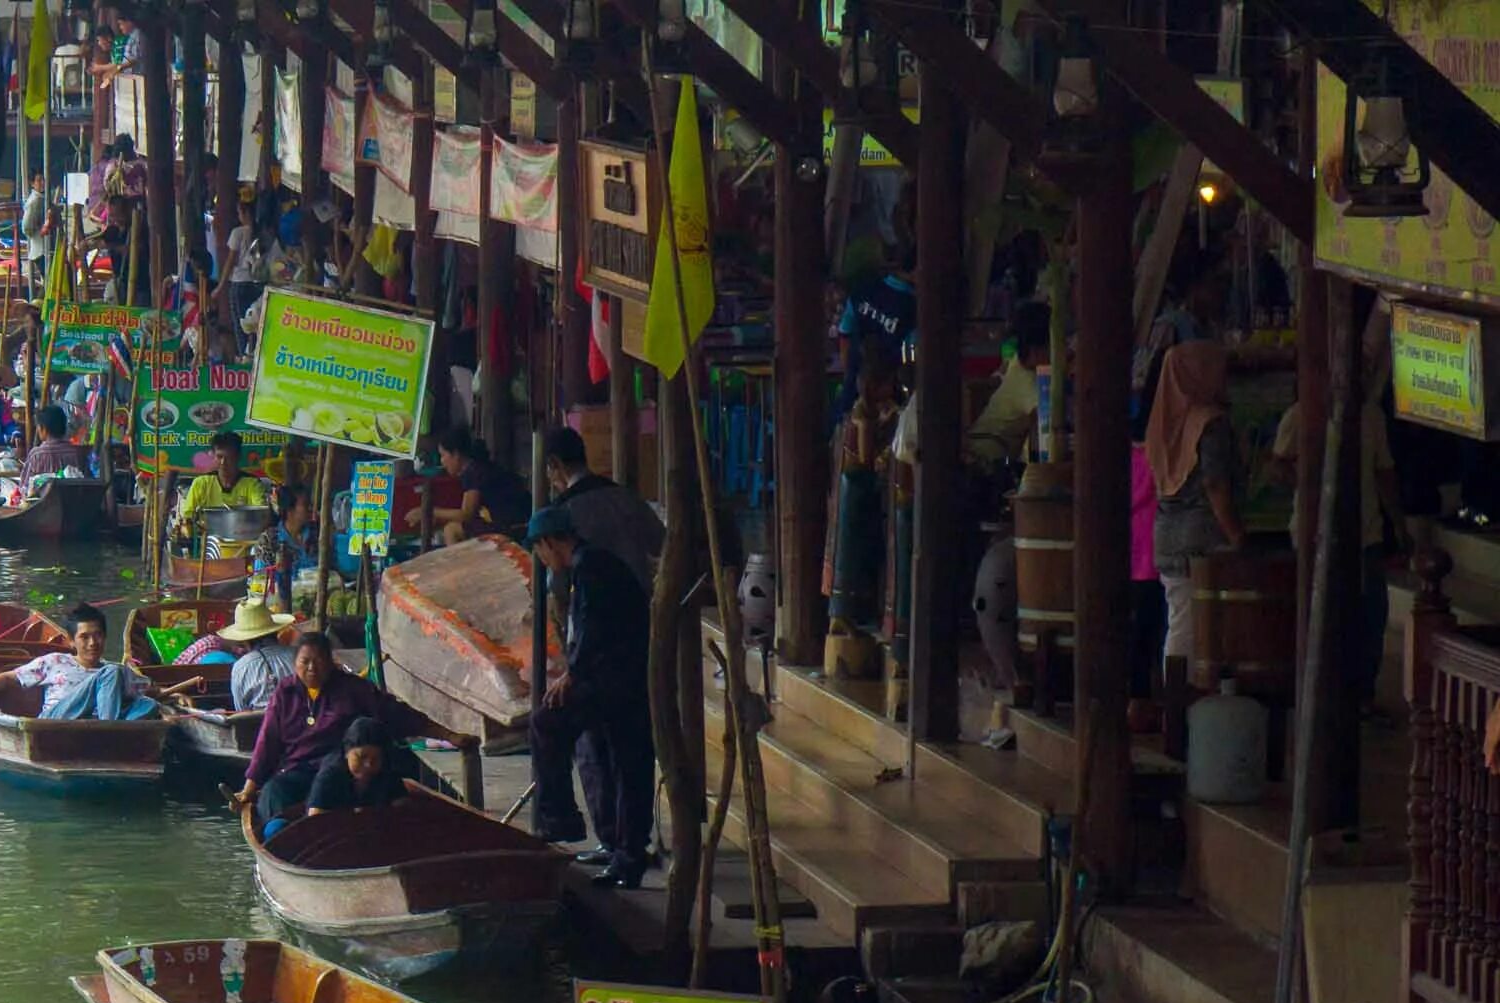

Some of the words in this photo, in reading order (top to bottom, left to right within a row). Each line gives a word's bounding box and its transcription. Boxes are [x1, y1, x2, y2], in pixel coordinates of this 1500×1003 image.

[280, 304, 417, 354] ข้าวเหนียวมะม่วง
[274, 345, 409, 394] ข้าวเหนียวทุเรียน
[142, 431, 180, 446] Dck
[187, 431, 216, 446] Por
